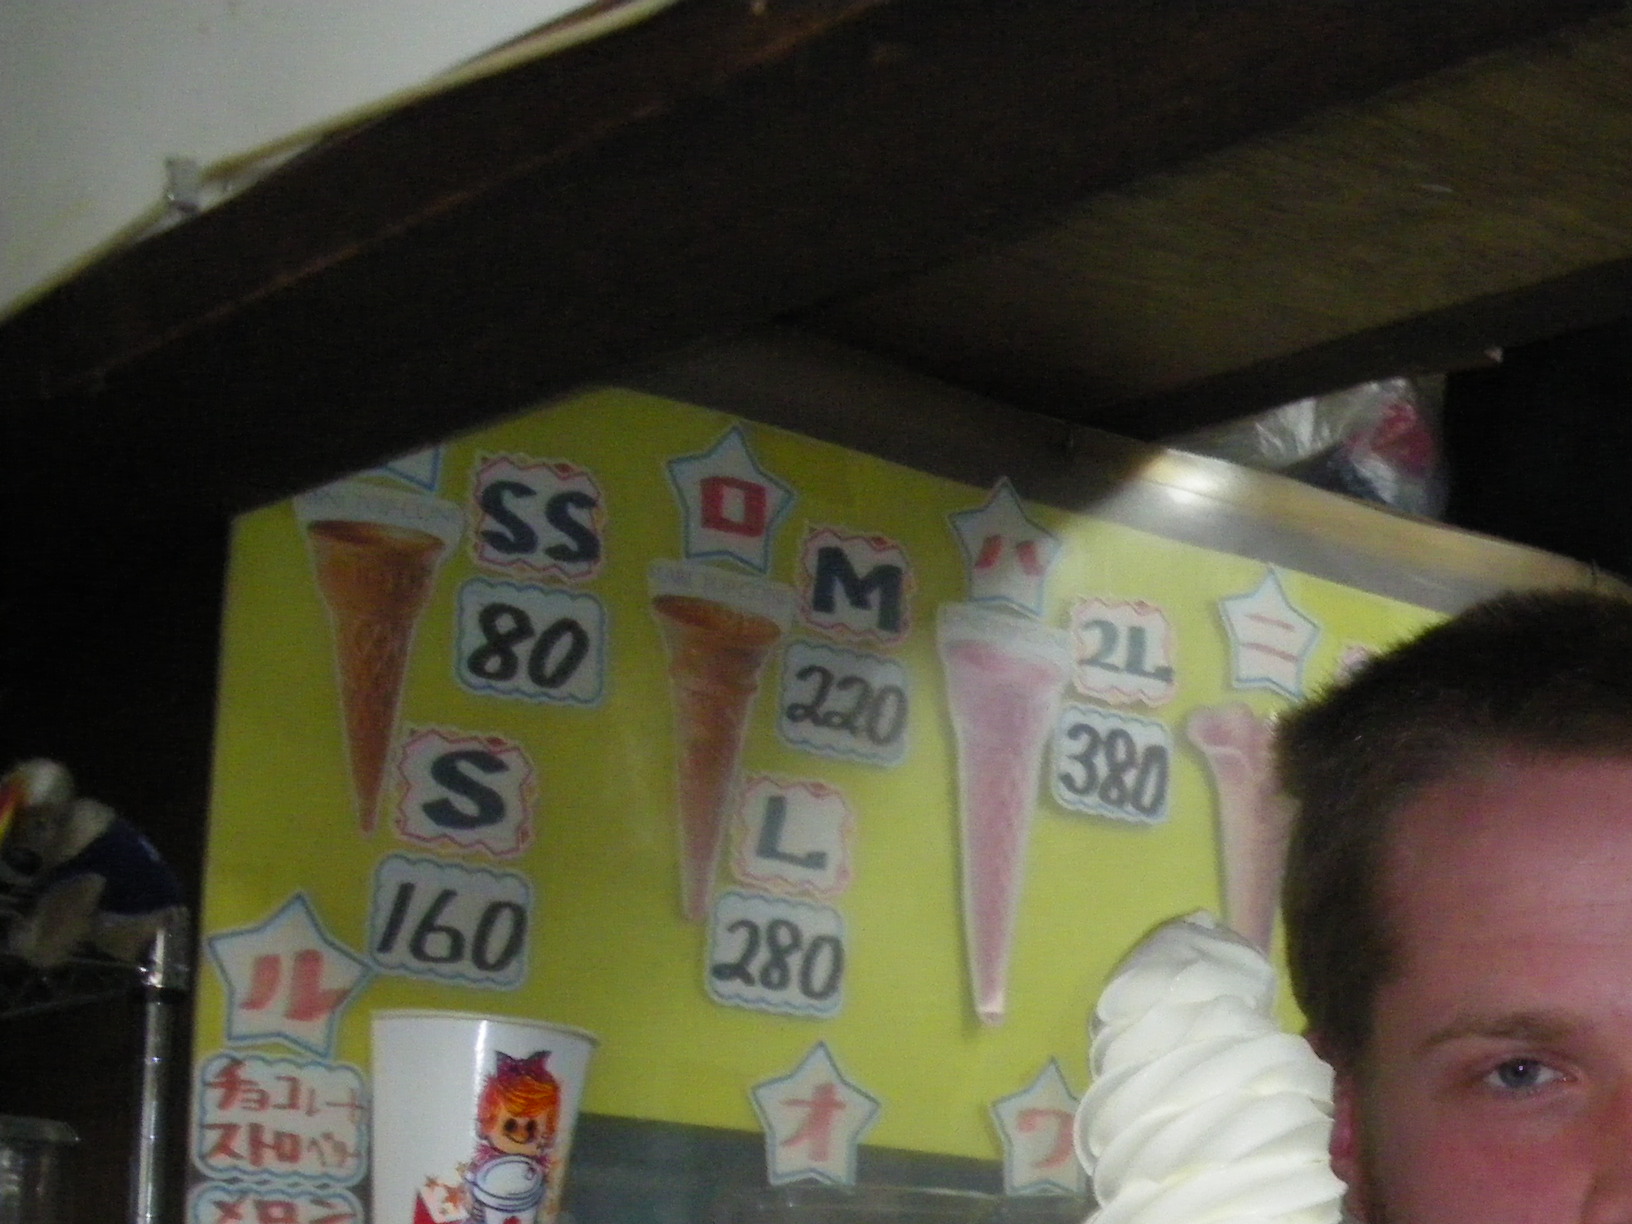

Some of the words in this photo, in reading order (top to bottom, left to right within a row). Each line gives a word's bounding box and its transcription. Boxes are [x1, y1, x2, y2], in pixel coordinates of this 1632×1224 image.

[478, 480, 598, 562] SS
[811, 546, 903, 631] M
[467, 602, 589, 688] 80
[1080, 618, 1175, 681] 2L
[785, 664, 904, 747] 220
[422, 750, 510, 829] S
[1059, 722, 1168, 818] 380
[757, 795, 827, 870] L
[376, 882, 528, 973] 160
[712, 918, 844, 1001] 280
